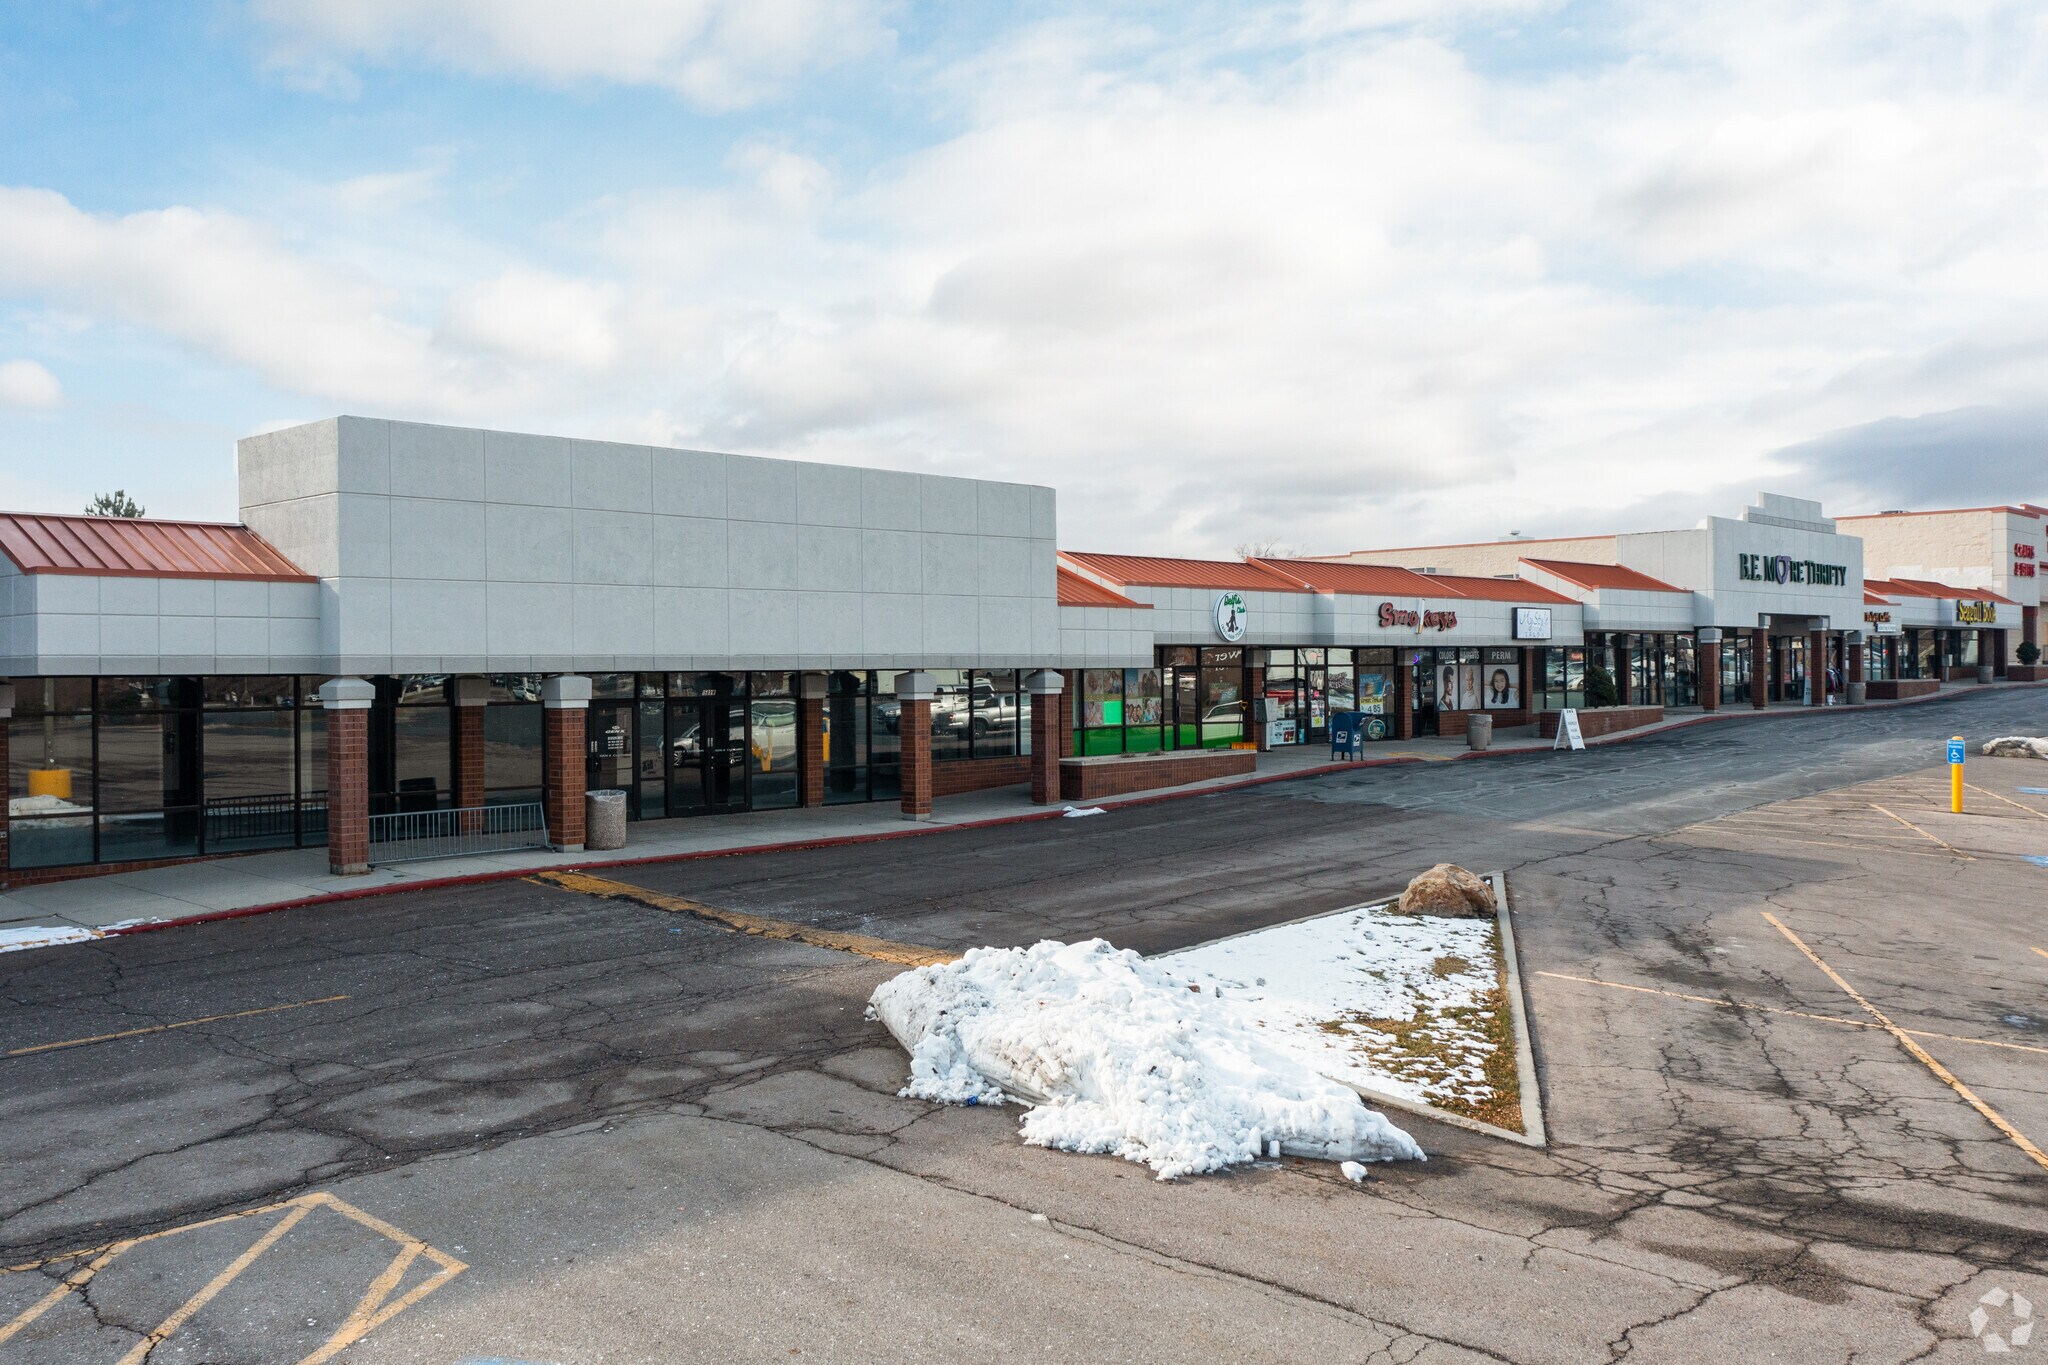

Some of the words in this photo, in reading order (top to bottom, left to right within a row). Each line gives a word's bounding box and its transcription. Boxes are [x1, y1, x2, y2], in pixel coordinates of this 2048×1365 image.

[1739, 553, 1762, 581] B.E.
[1804, 560, 1846, 586] THRIFTY
[1378, 602, 1457, 632] Smokeys
[1491, 651, 1511, 660] PERM
